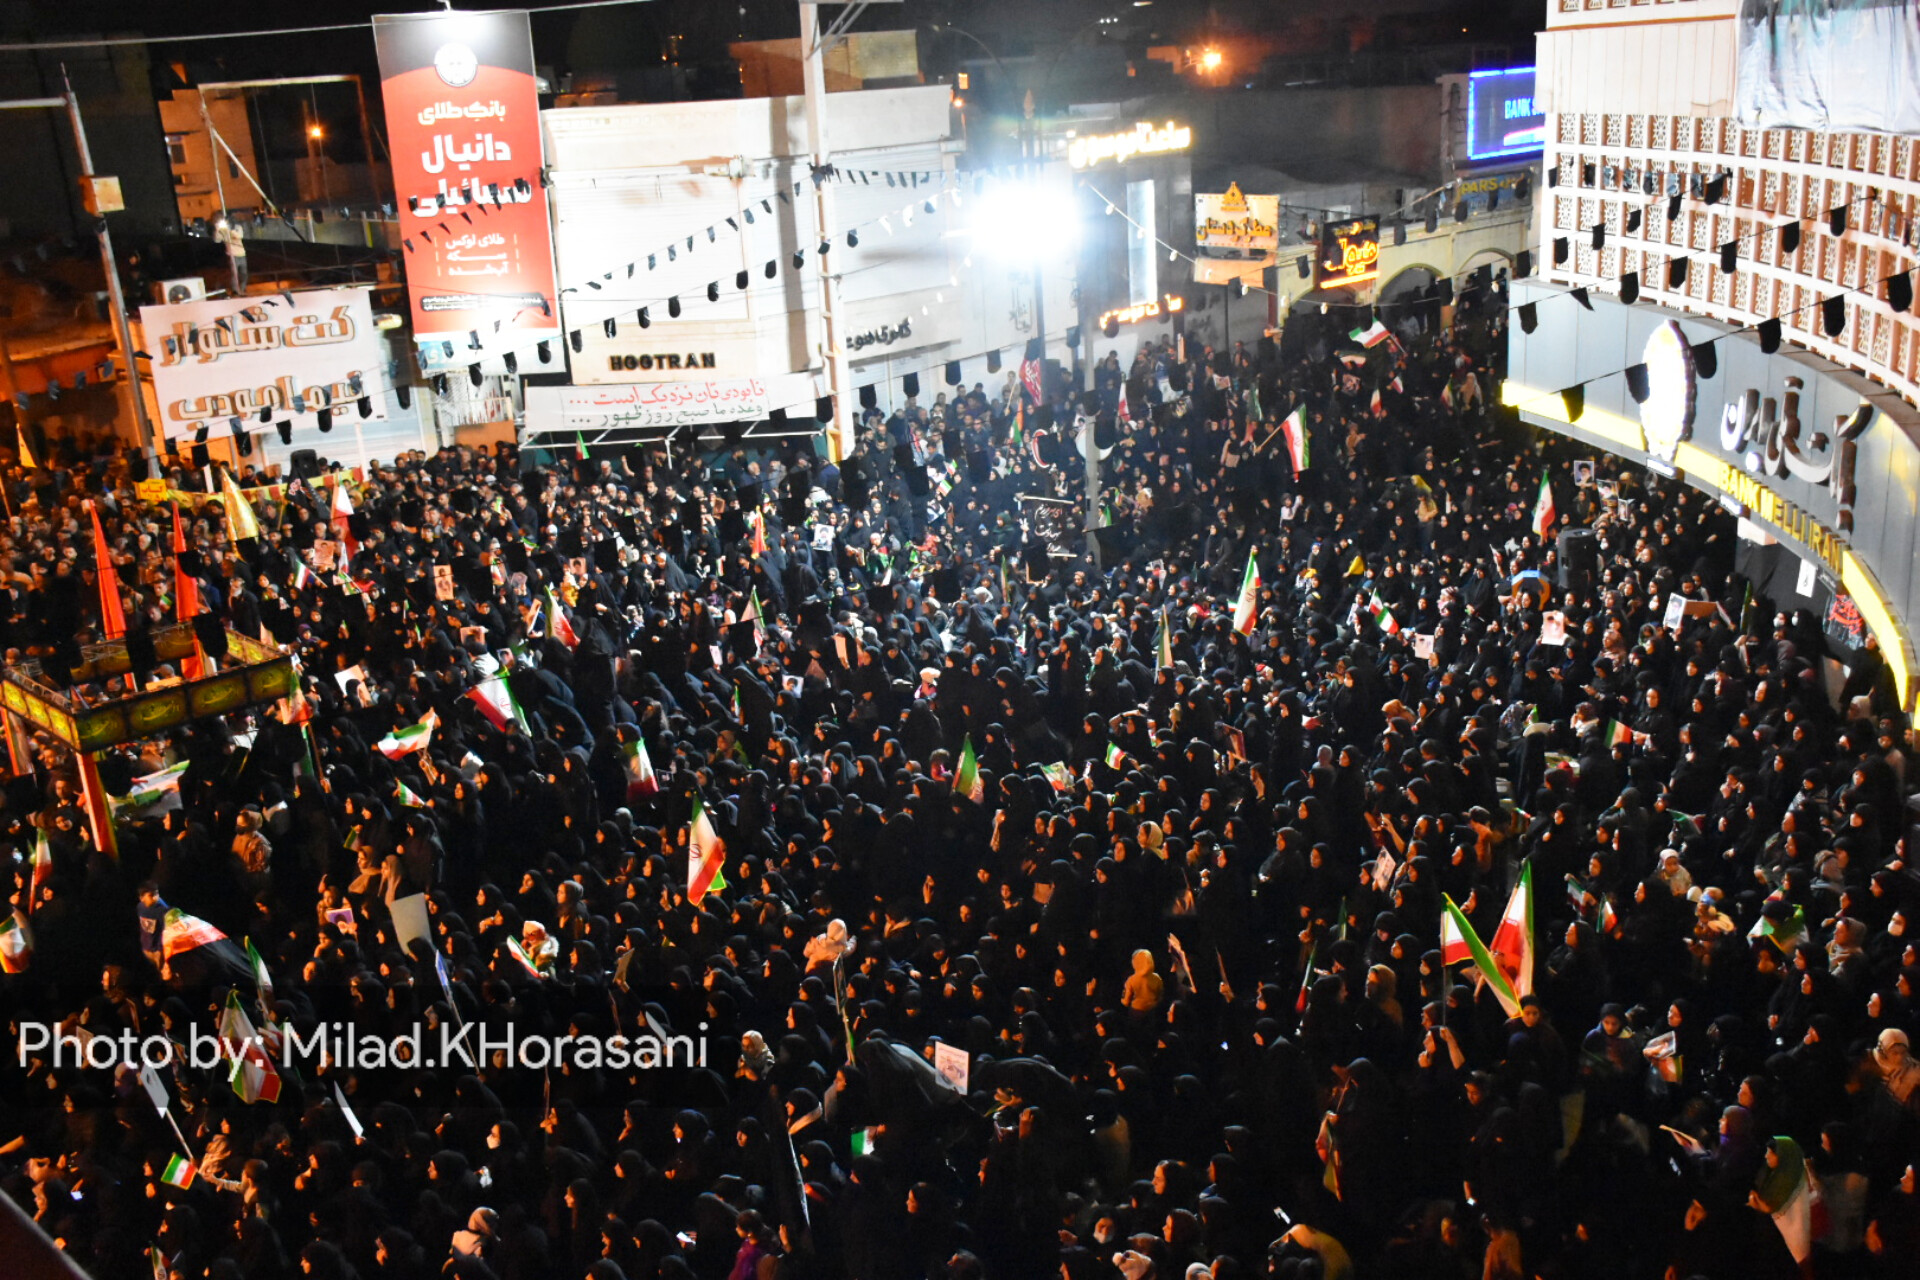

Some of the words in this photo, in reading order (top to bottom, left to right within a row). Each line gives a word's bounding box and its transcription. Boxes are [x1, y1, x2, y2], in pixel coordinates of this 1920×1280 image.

[421, 132, 512, 174] دانیال
[445, 234, 476, 250] لوکس
[478, 233, 506, 248] طلای
[160, 305, 280, 367] شلوار
[284, 305, 355, 347] کت
[593, 385, 639, 405] است
[641, 384, 693, 409] نزدیک
[695, 381, 719, 403] تان
[721, 378, 765, 403] نابودی
[600, 404, 642, 427] ظهور
[646, 409, 673, 424] روز
[713, 402, 726, 414] ما
[1718, 461, 1764, 514] BANK
[1761, 484, 1809, 543] MELLI
[1808, 515, 1850, 576] IRAN
